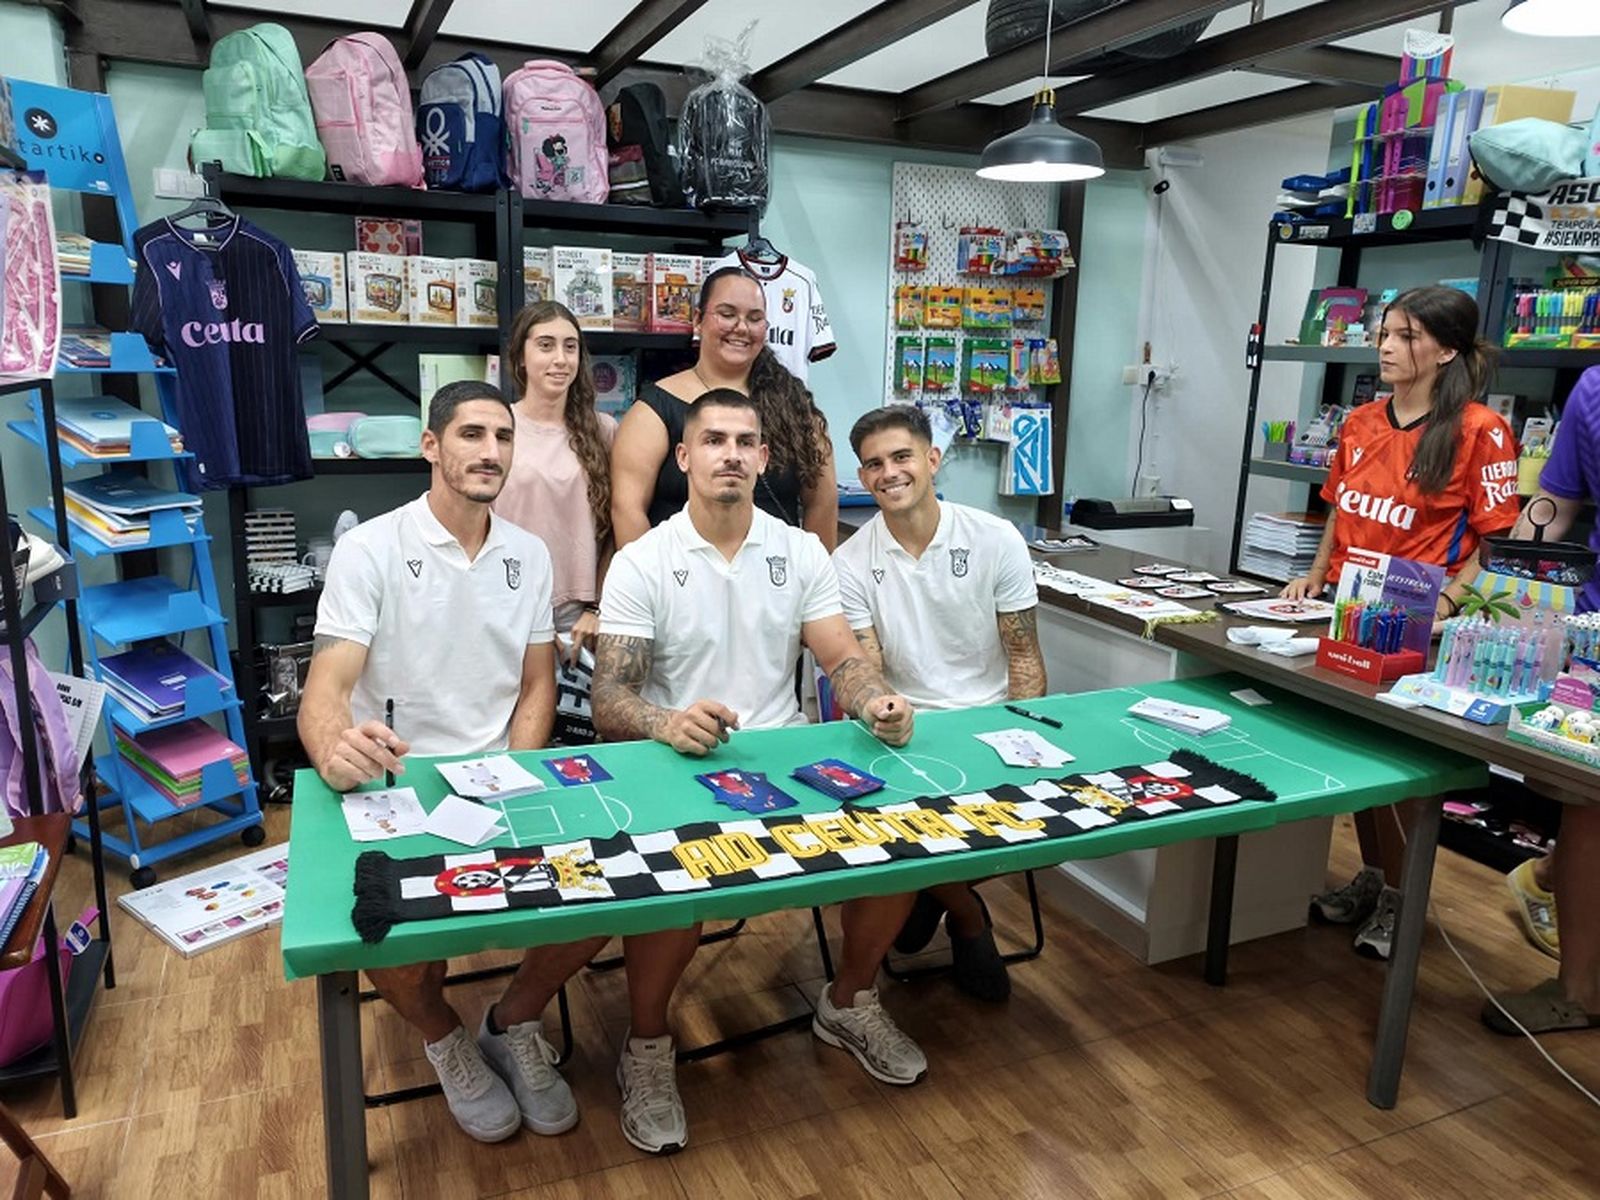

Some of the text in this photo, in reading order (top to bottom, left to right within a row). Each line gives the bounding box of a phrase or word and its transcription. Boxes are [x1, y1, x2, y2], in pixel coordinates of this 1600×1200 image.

[672, 802, 1045, 880] AD CEUTA FC
